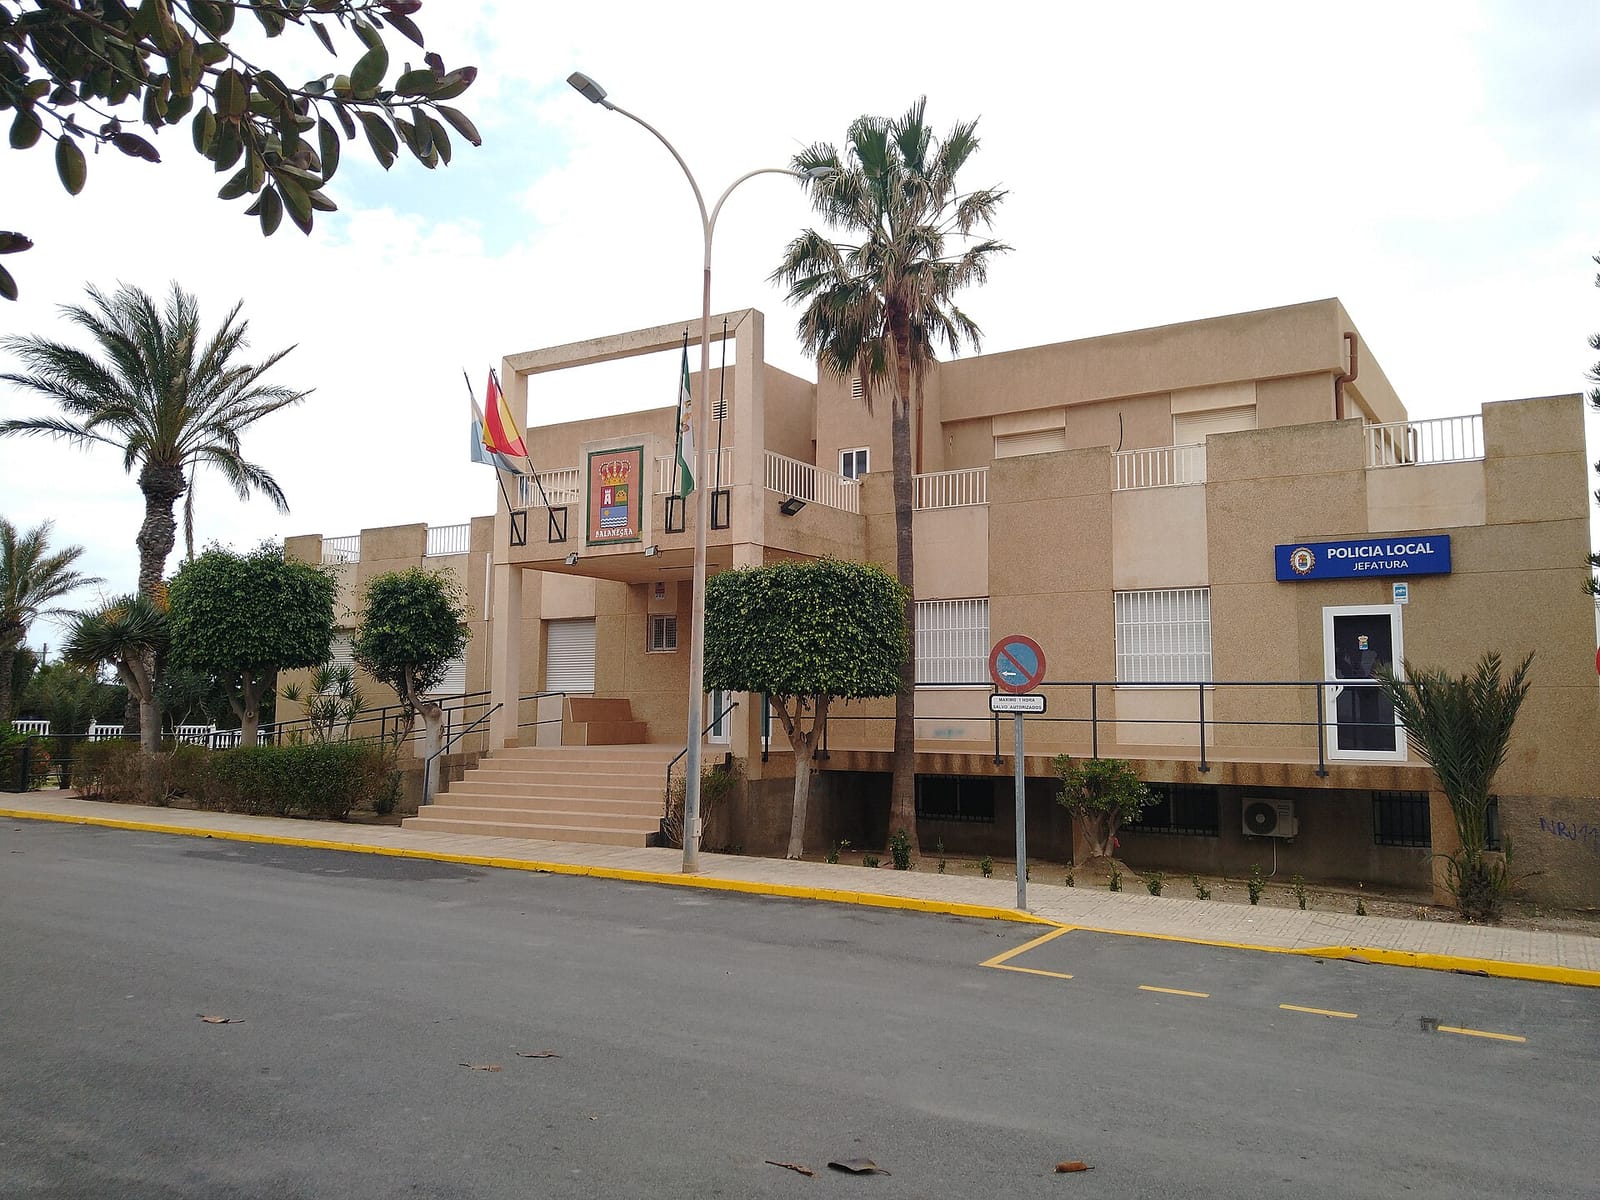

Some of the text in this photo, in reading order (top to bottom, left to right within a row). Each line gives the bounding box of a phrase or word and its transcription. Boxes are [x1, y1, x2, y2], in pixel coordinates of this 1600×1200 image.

[595, 528, 633, 538] BALANEGRA
[1327, 542, 1434, 559] POLICIA LOCAL
[1353, 560, 1409, 571] JEFATURA
